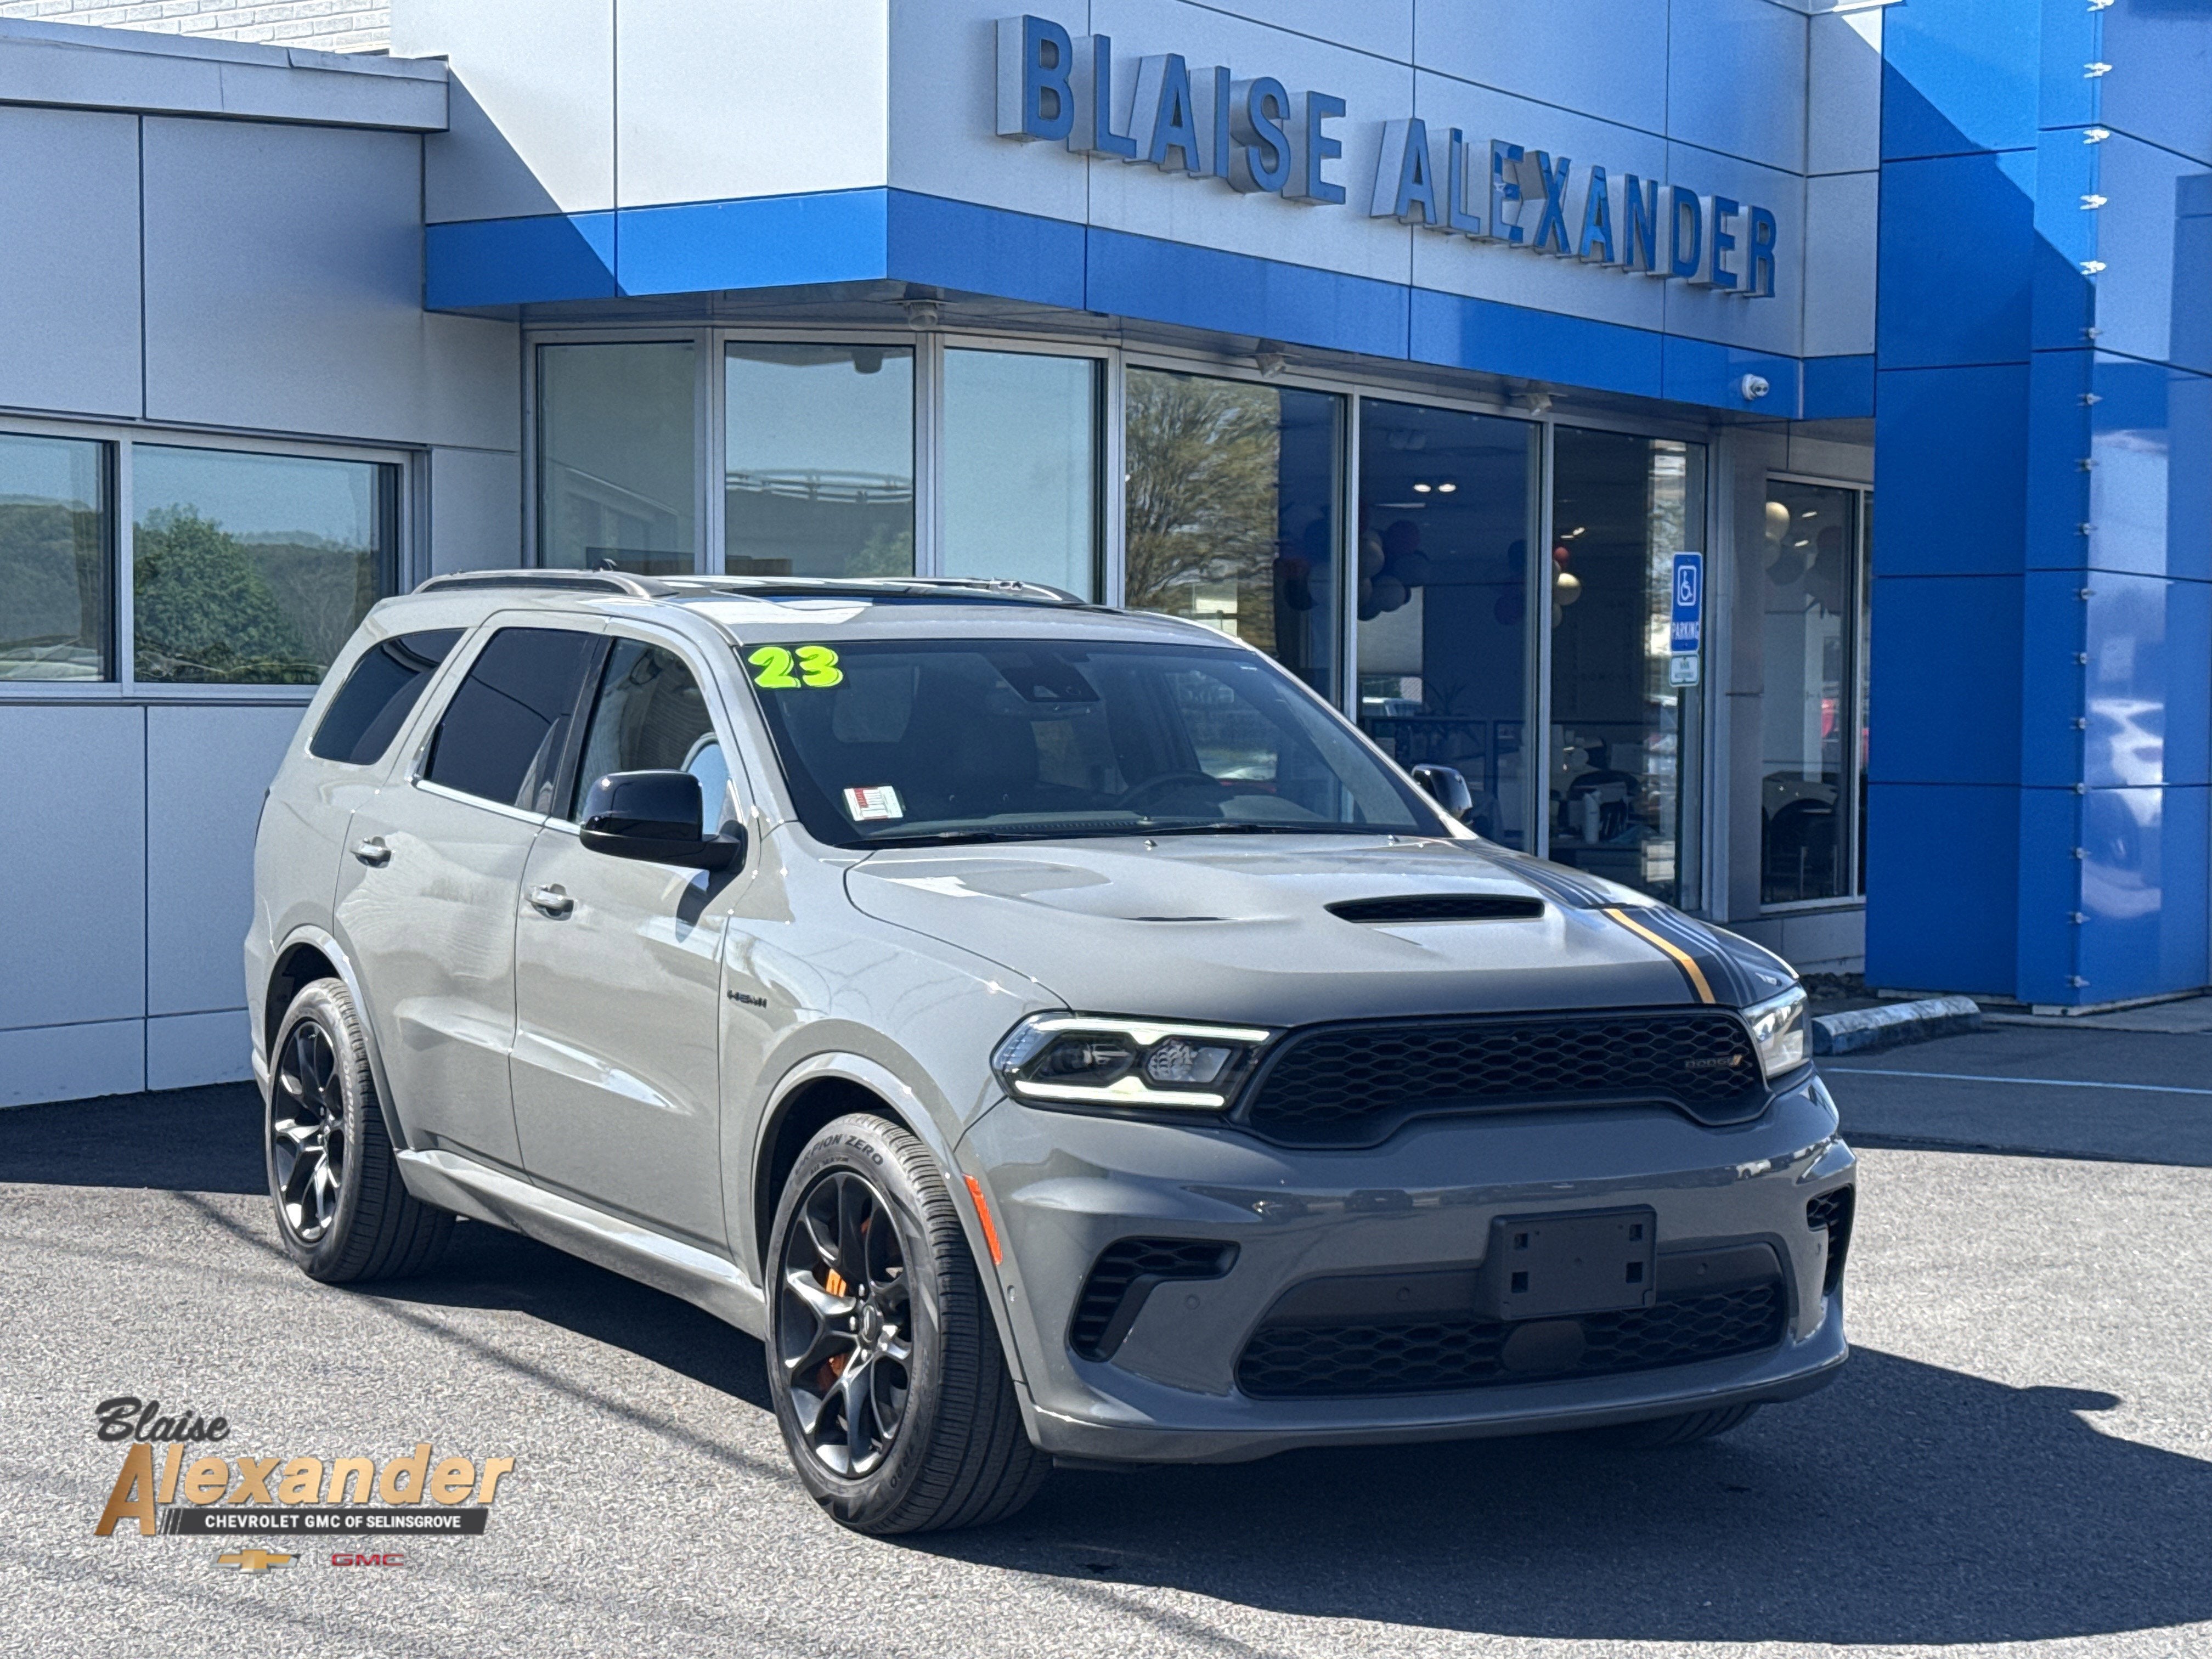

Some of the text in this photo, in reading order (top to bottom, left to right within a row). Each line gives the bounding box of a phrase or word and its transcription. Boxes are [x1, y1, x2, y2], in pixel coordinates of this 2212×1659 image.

[1015, 14, 1778, 298] BLAISE ALEXANDER
[1672, 621, 1700, 641] PARKING
[747, 645, 844, 689] 23
[845, 1135, 884, 1166] ZERO
